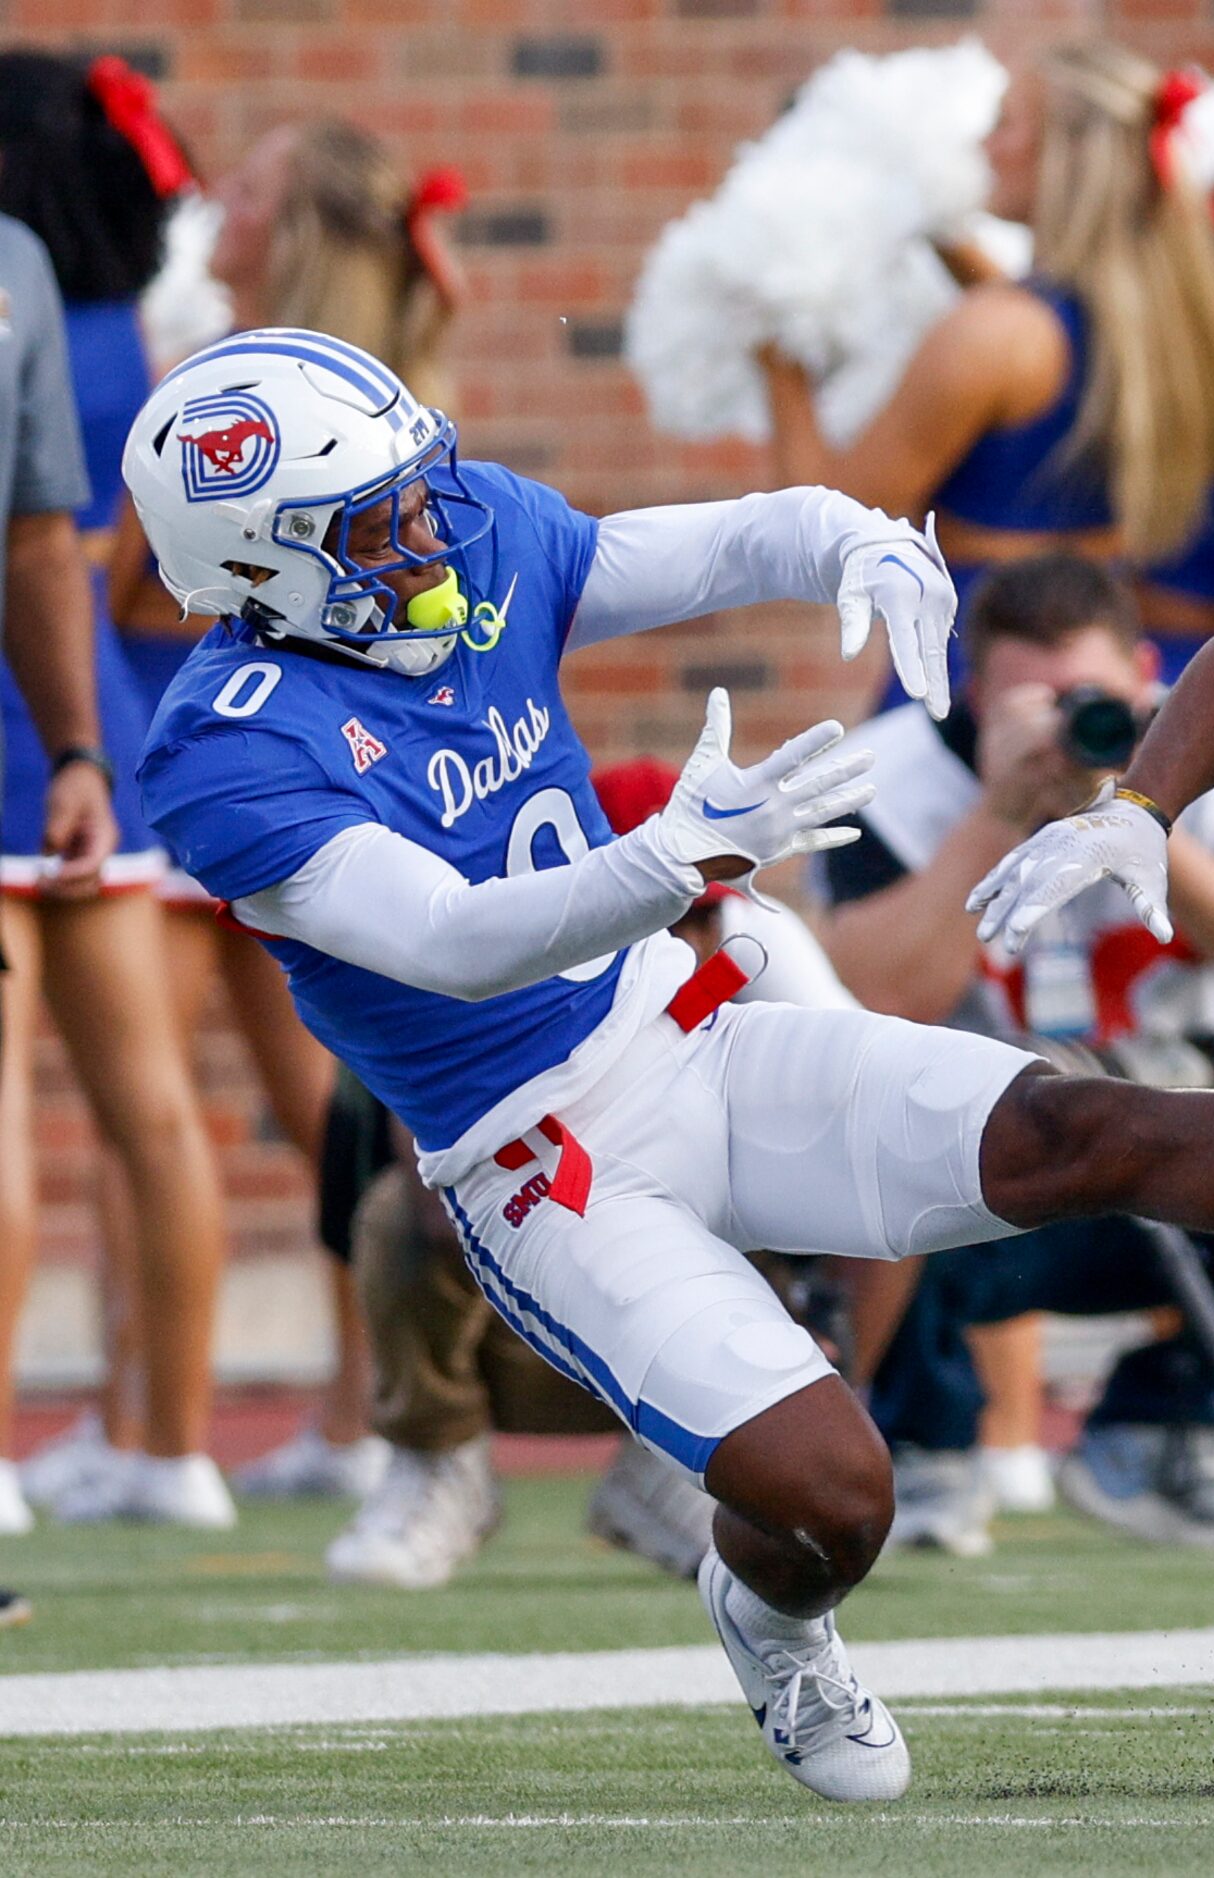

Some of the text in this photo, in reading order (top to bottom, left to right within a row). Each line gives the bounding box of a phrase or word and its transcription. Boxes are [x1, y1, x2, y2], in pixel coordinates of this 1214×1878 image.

[212, 661, 283, 719] 0
[427, 697, 550, 828] Dallas
[503, 1171, 553, 1229] SMU
